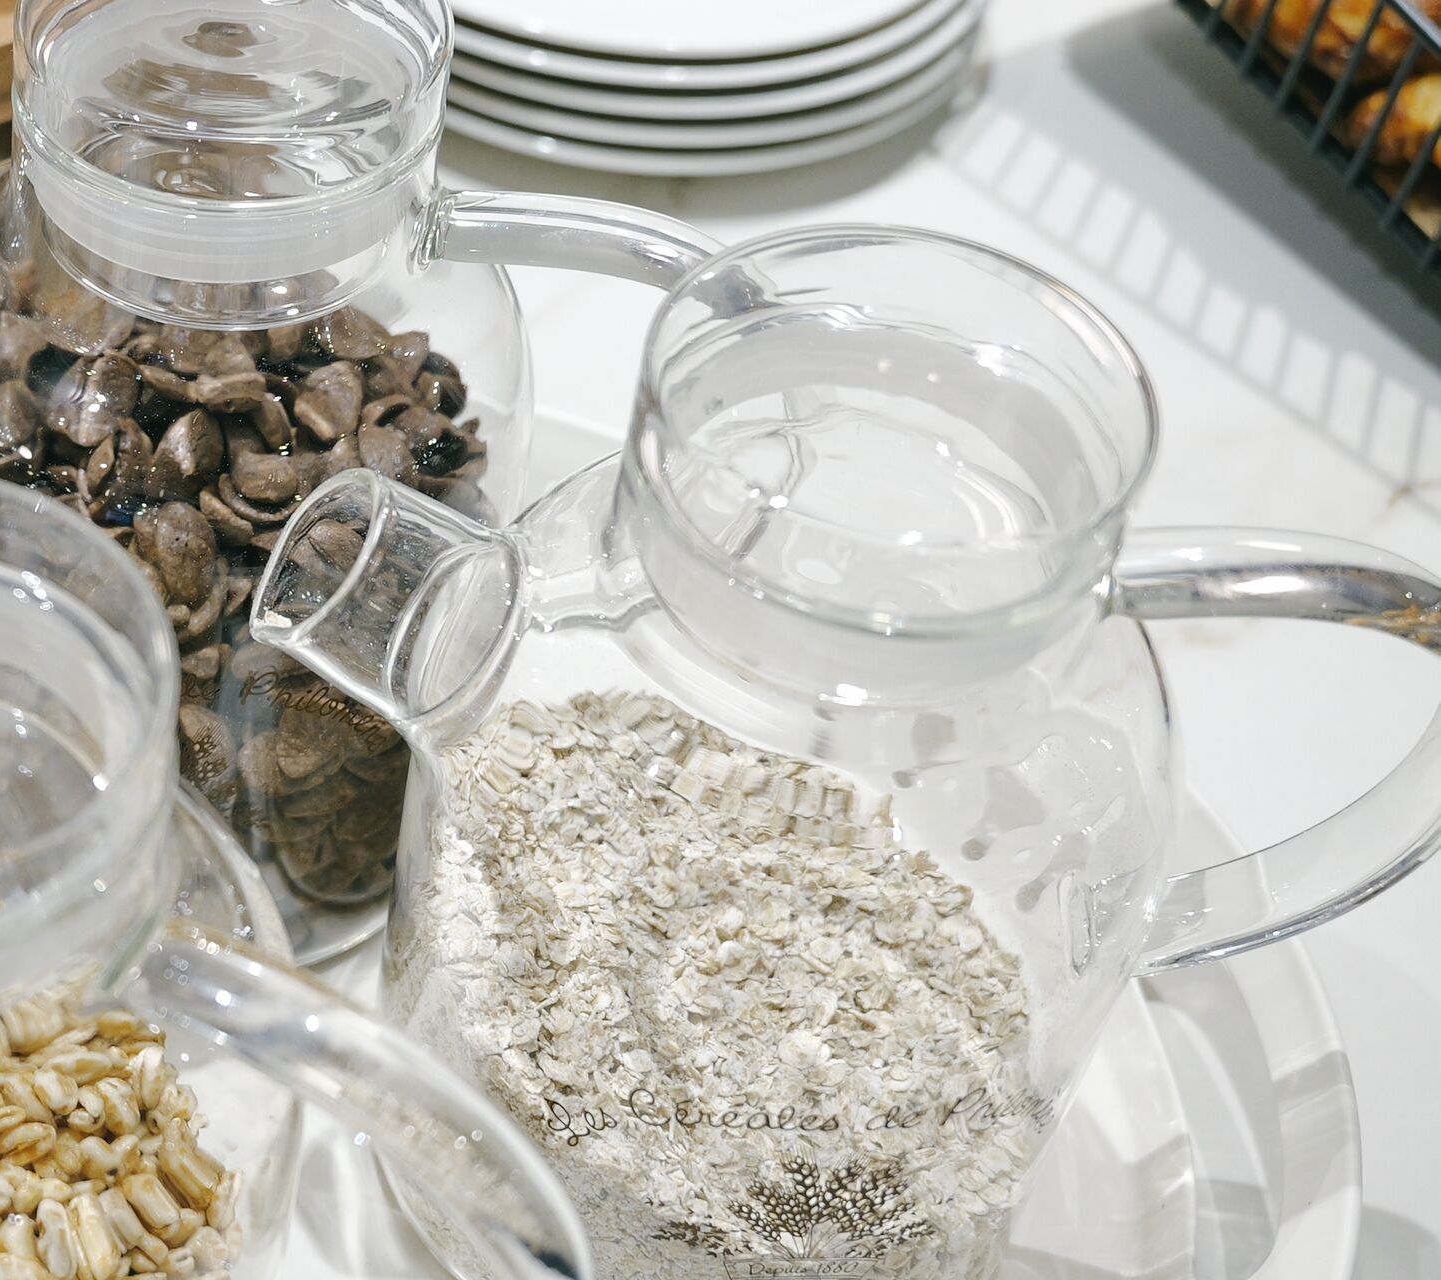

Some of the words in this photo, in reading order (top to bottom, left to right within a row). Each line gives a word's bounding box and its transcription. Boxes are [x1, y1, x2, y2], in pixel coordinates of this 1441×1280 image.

[543, 1096, 619, 1147] Les
[865, 1104, 922, 1131] de
[747, 1261, 809, 1278] Depuis
